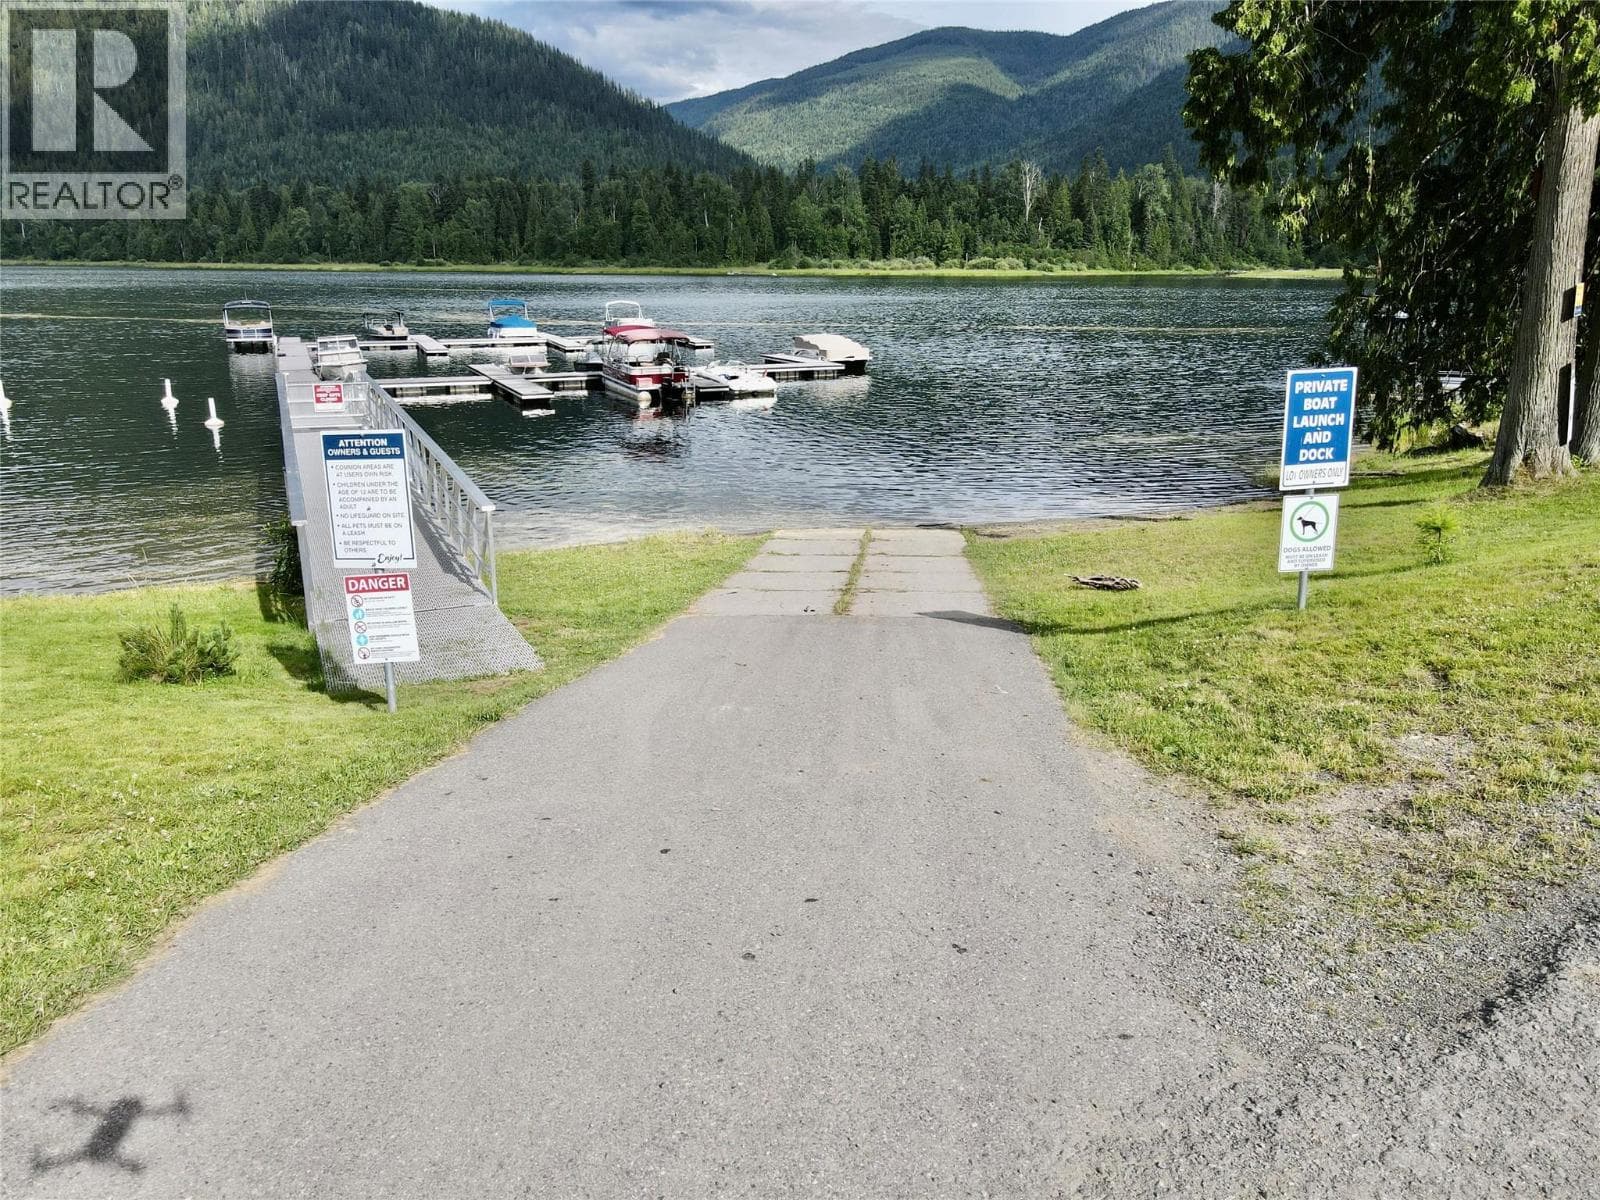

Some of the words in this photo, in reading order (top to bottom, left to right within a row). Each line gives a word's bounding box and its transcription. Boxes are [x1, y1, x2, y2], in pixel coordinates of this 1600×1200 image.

[1295, 379, 1348, 394] PRIVATE
[1304, 397, 1338, 410] BOAT
[1293, 413, 1345, 428] LAUNCH
[339, 438, 387, 447] ATTENTION
[1303, 431, 1332, 444] AND
[1299, 448, 1334, 462] DOCK
[1299, 468, 1326, 480] OWNERS
[378, 553, 403, 563] Enjoy!
[348, 577, 406, 591] DANGER
